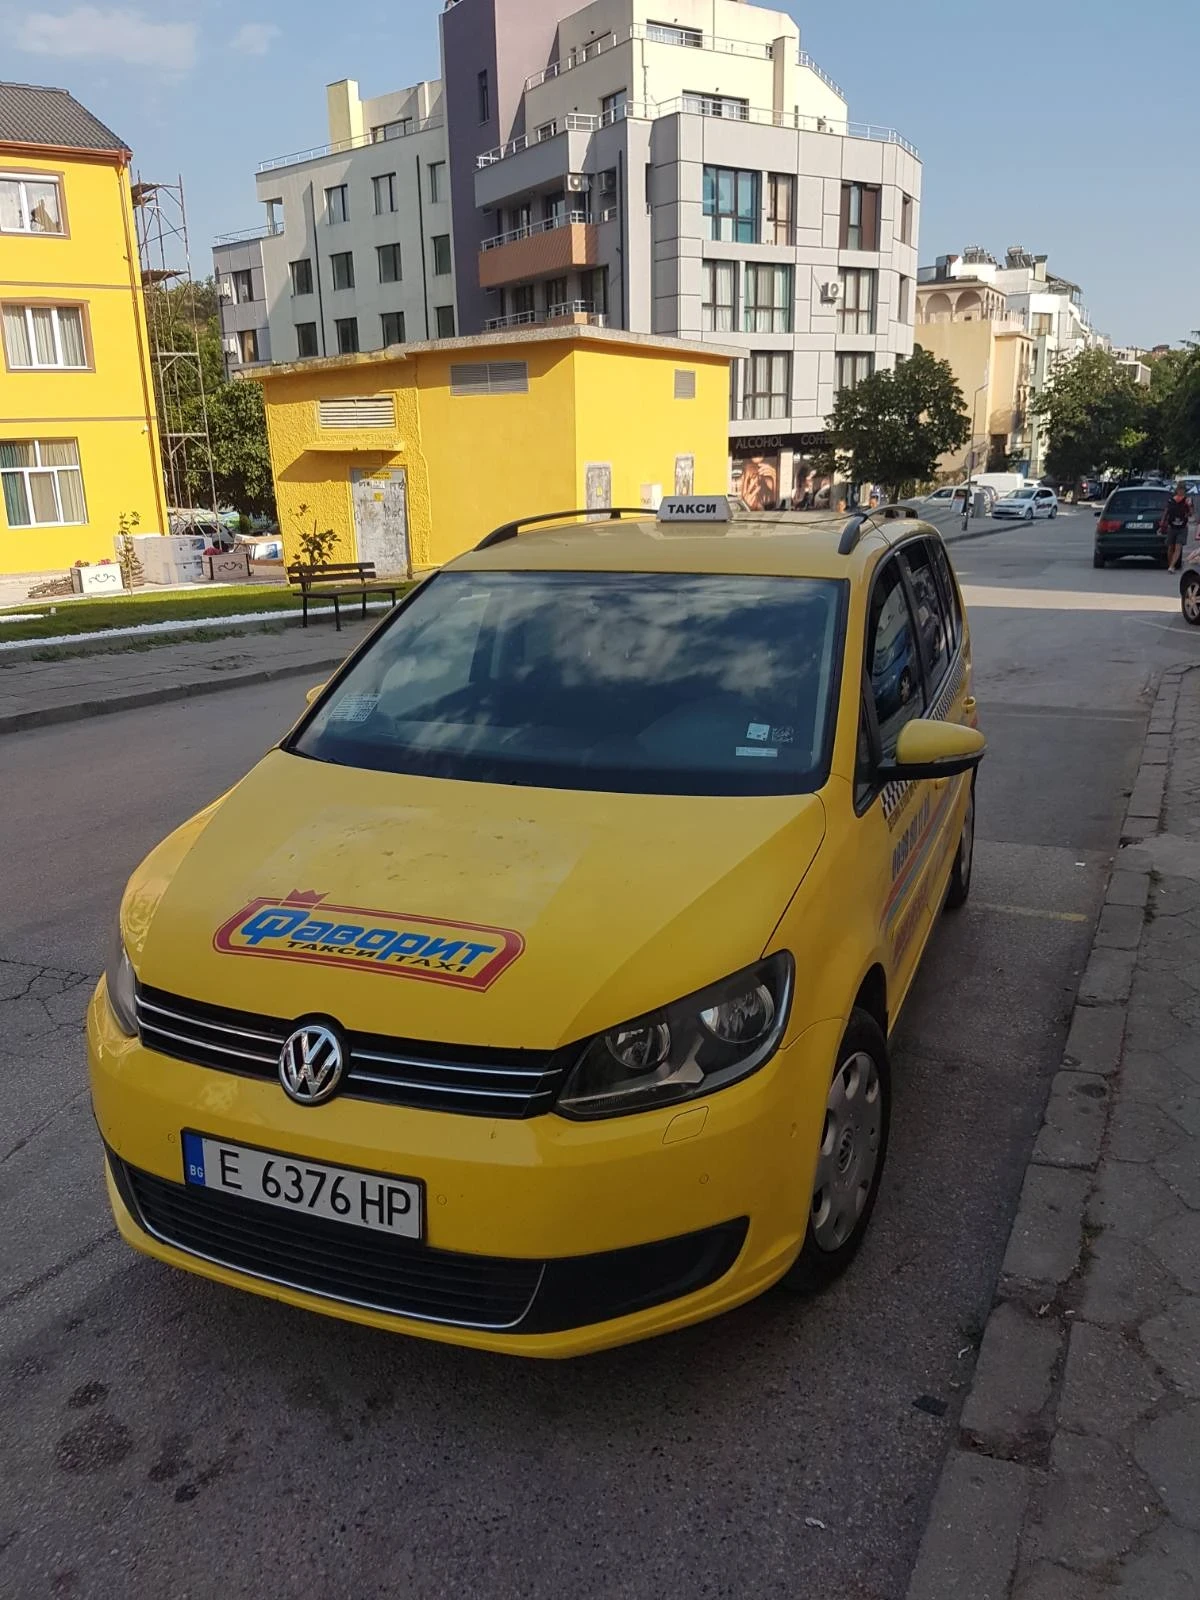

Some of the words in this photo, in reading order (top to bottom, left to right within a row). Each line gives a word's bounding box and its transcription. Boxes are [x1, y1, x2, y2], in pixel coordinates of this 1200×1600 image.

[736, 436, 784, 449] ALCOHOL
[667, 503, 717, 514] ТАКСИ
[240, 908, 497, 964] Фаворит
[287, 941, 379, 958] ТАКСИ
[394, 954, 467, 973] TAXI
[189, 1164, 204, 1178] BG
